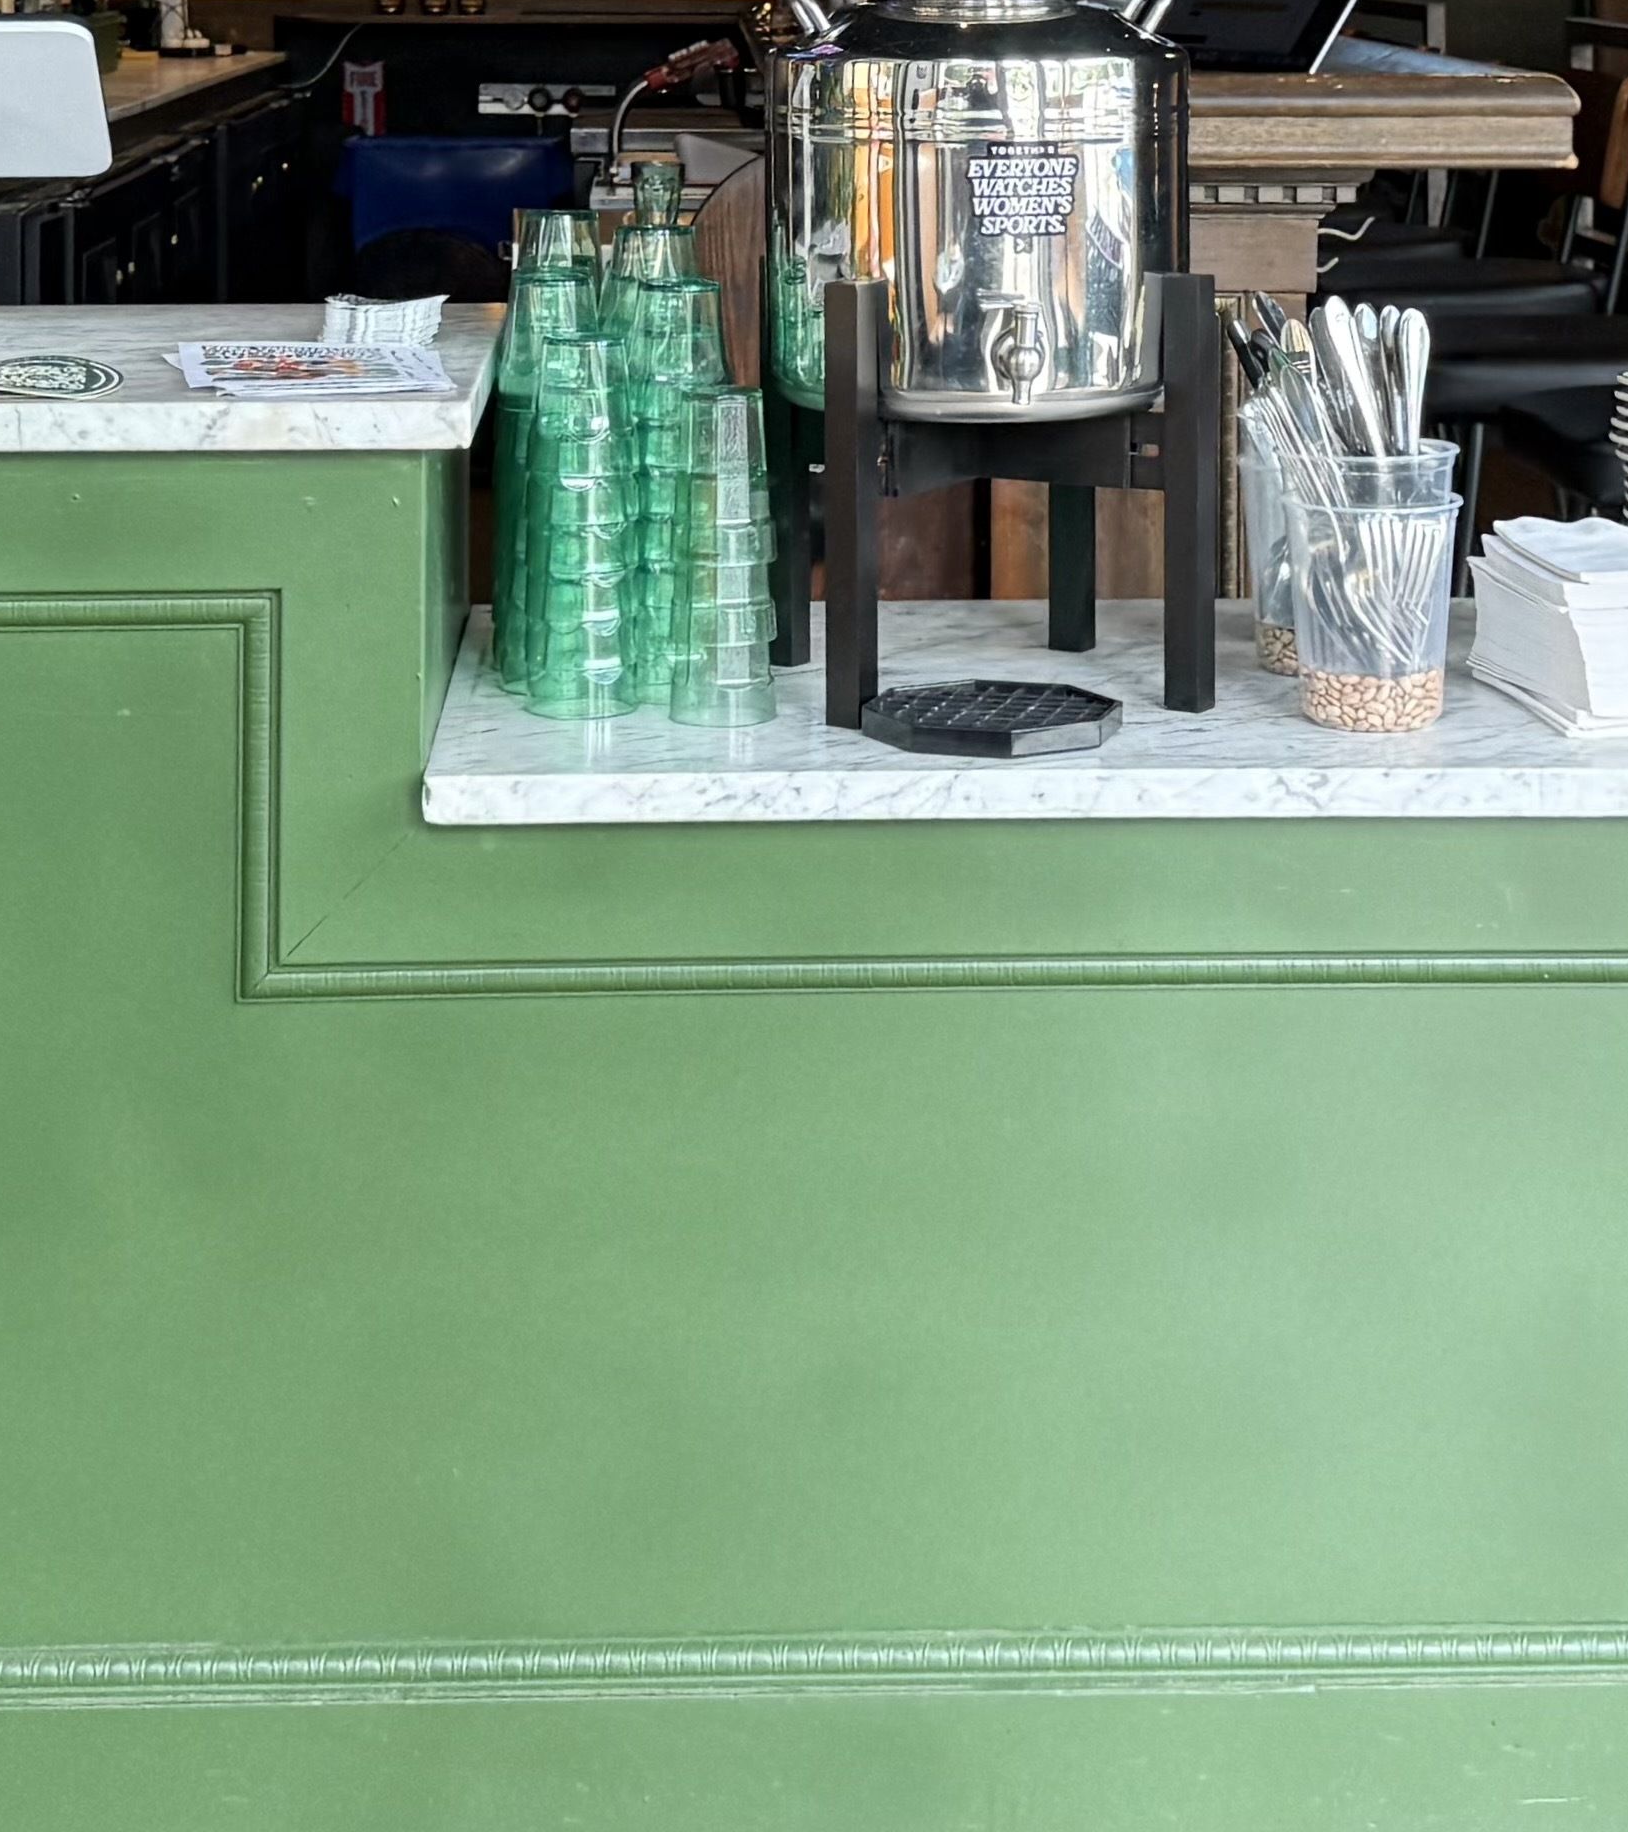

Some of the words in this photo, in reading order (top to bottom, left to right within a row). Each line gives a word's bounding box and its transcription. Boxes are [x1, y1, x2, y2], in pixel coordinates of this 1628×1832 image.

[967, 157, 1077, 178] EVERYONE
[972, 177, 1073, 197] WATCHES
[972, 196, 1073, 216] WOMEN'S
[980, 215, 1066, 235] SPORTS.
